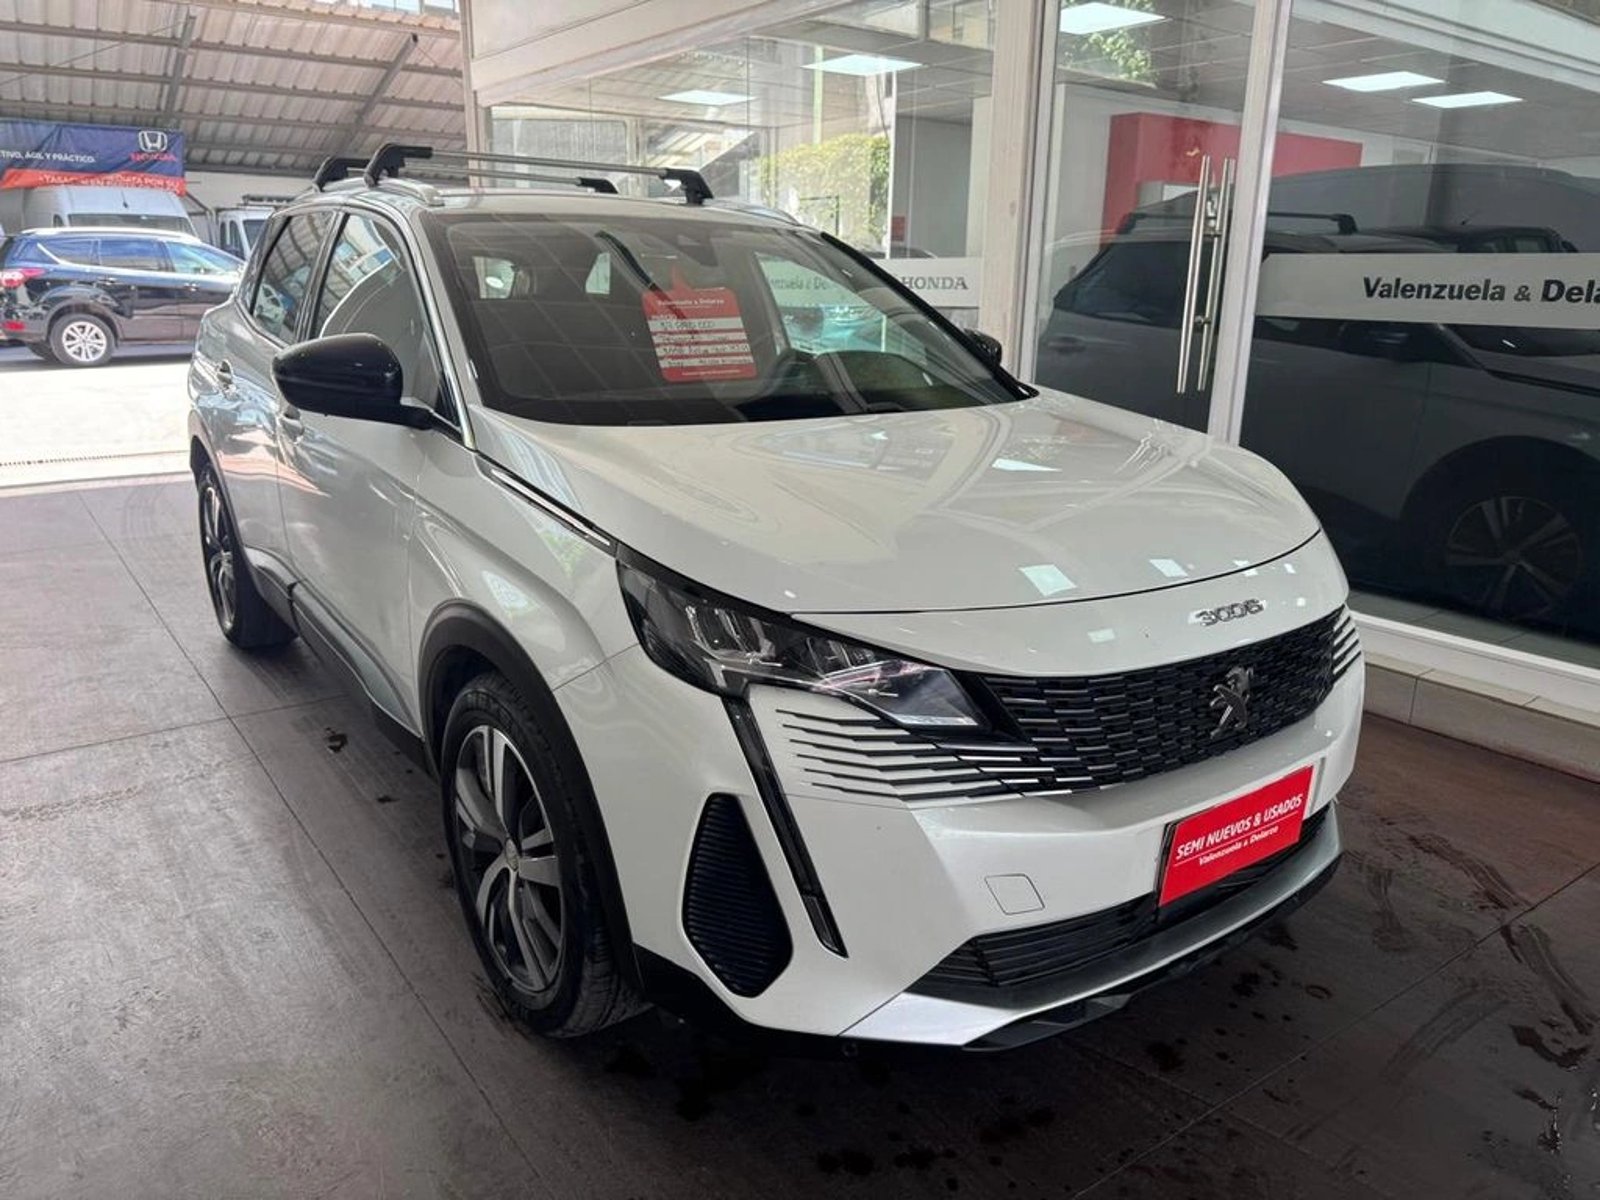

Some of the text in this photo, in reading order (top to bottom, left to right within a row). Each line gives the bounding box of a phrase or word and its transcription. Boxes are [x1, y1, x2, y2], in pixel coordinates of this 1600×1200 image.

[901, 276, 968, 290] HONDA
[1363, 276, 1506, 301] Valenzuela
[1514, 285, 1531, 301] &
[1176, 793, 1303, 860] SEMI NUEVOS & USADOS
